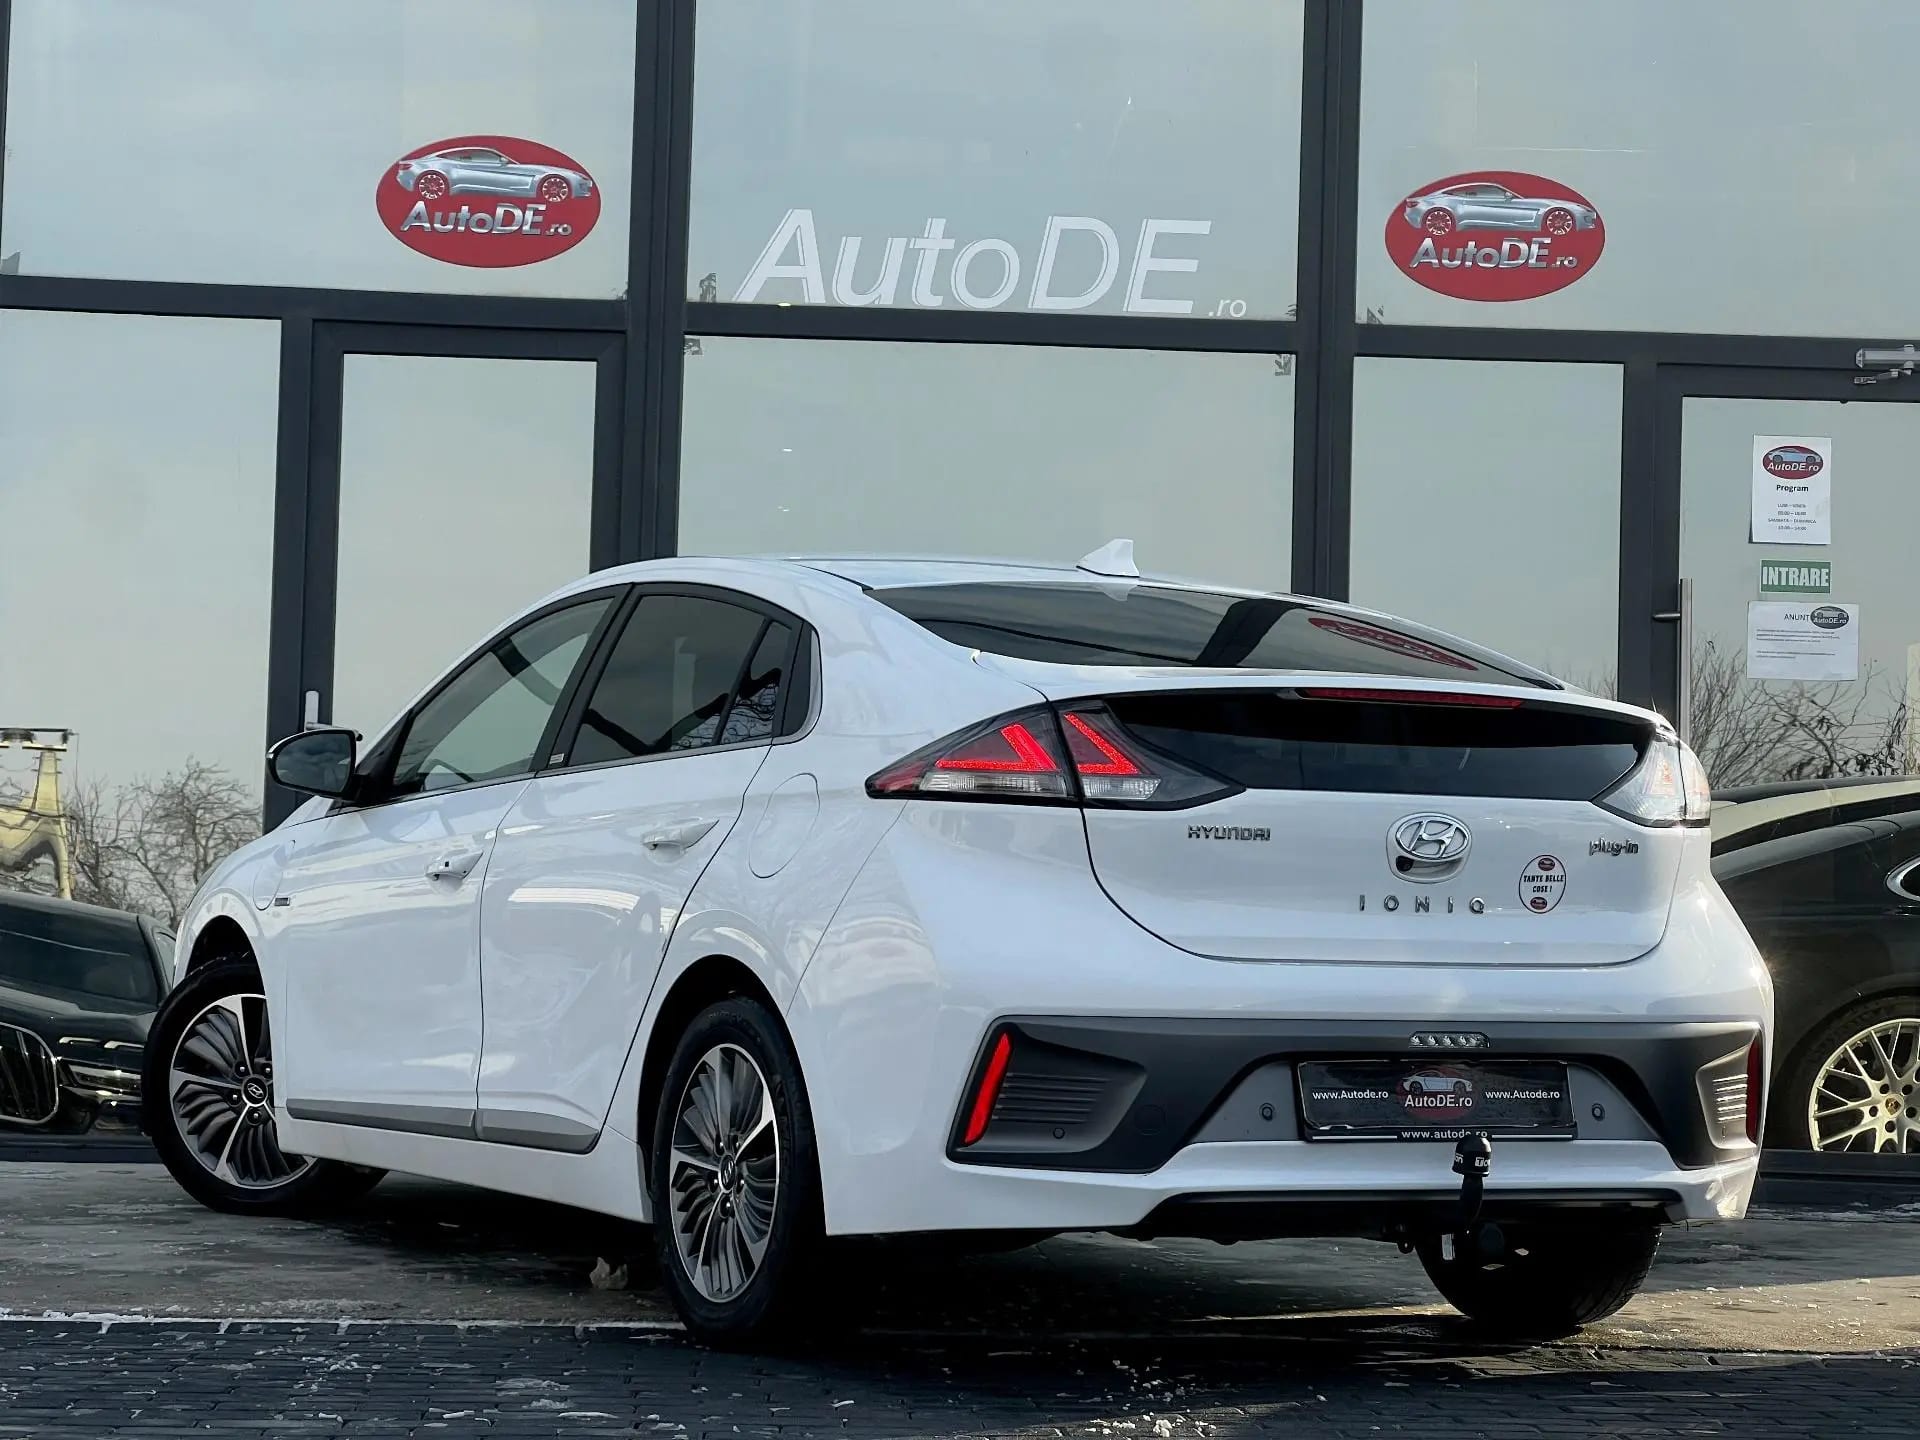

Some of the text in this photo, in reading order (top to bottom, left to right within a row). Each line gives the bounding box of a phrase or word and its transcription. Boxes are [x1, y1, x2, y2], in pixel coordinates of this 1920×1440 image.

[1767, 462, 1819, 472] AutoDE.ro
[1776, 484, 1809, 493] Program
[1762, 566, 1829, 587] INTRARE
[1187, 824, 1271, 842] HYUNDAI
[1588, 837, 1639, 857] plug-in
[1523, 874, 1564, 883] TANTE BELLE
[1532, 885, 1549, 893] COSE
[1358, 894, 1485, 914] IONIQ
[1312, 1090, 1389, 1100] www.Autode.ro
[1485, 1090, 1560, 1100] www.Autode.ro
[1404, 1094, 1473, 1108] AutoDE.ro
